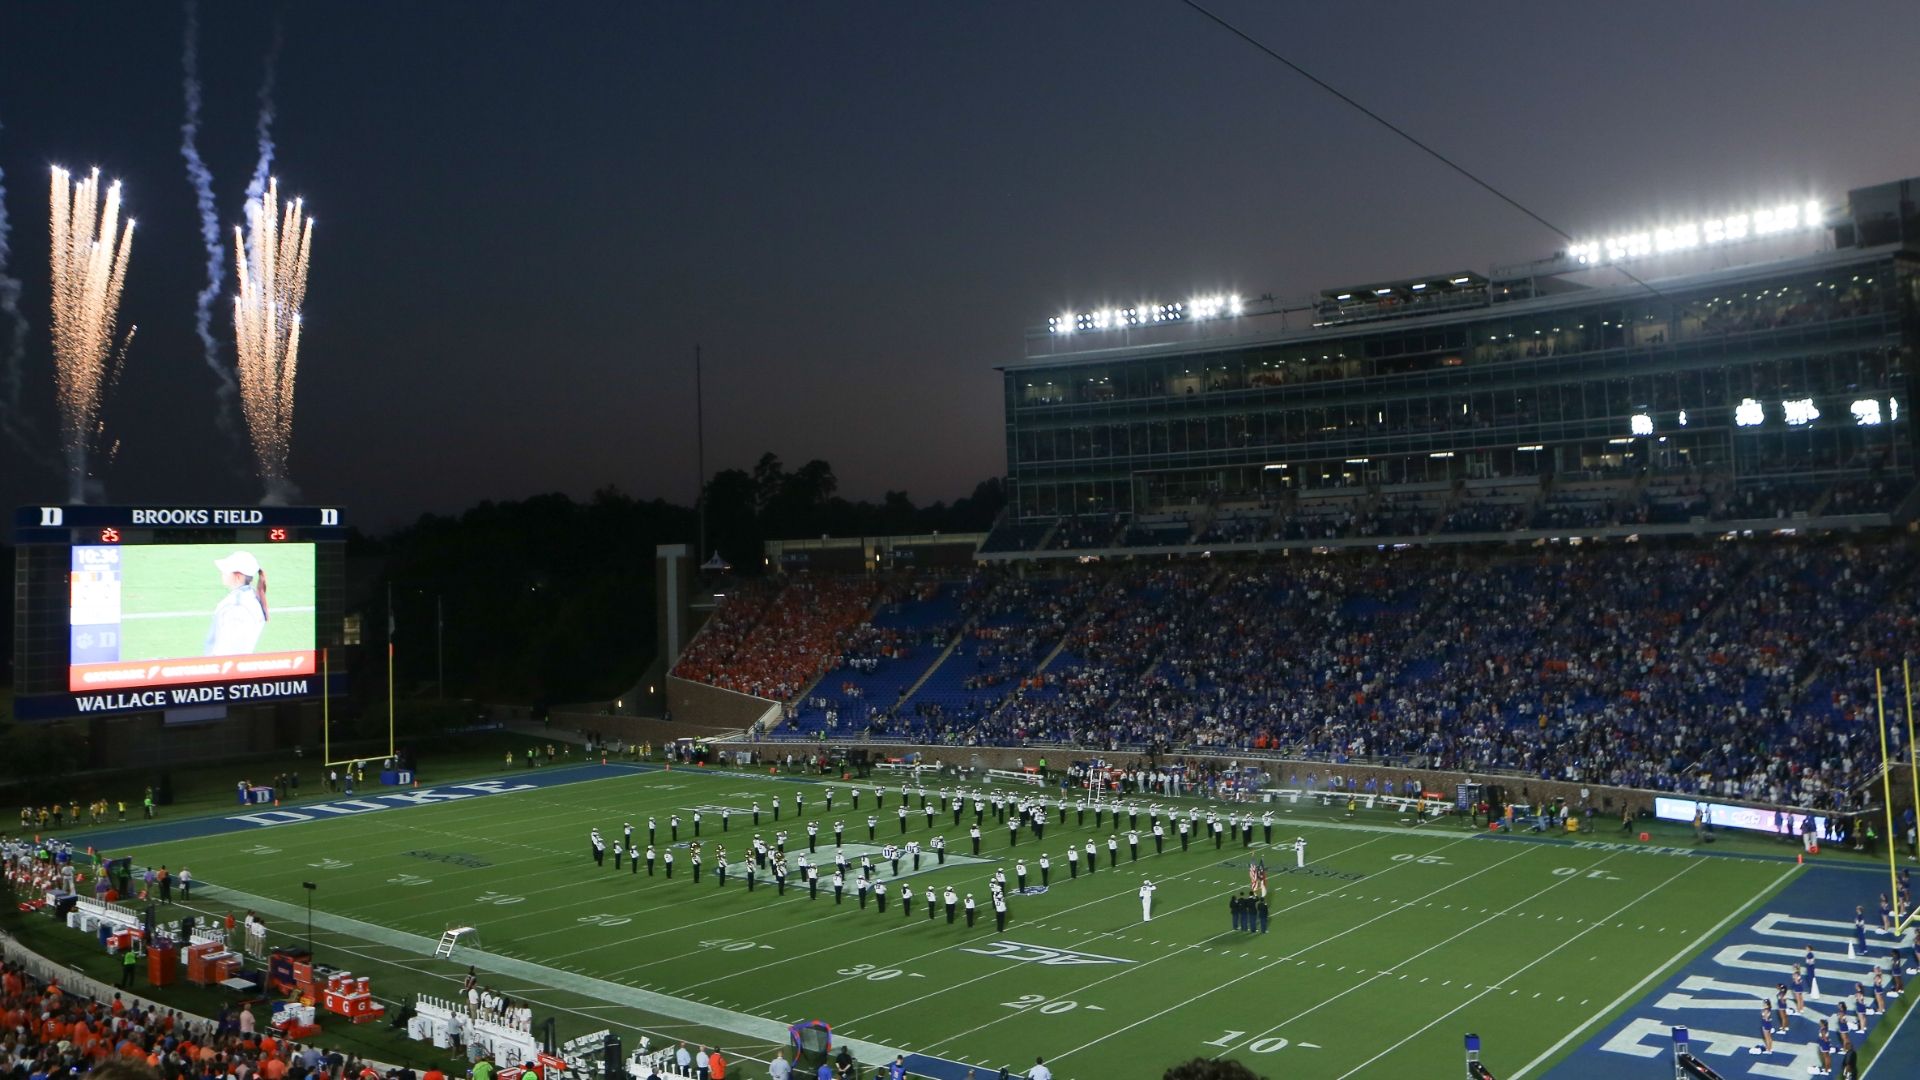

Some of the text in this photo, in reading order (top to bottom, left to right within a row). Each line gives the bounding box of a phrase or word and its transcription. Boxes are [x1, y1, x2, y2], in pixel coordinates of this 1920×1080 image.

[40, 507, 63, 526] D
[132, 509, 263, 525] BROOKS FIELD
[320, 508, 338, 526] D
[102, 530, 120, 543] 25
[270, 529, 285, 540] 25
[75, 680, 308, 712] WALLACE WADE STADIUM
[225, 780, 538, 827] DUKE
[837, 963, 903, 981] 30
[326, 995, 333, 1007] G
[1000, 994, 1079, 1014] 20
[1599, 912, 1919, 1080] DUKE
[342, 1001, 349, 1012] G
[358, 1002, 365, 1011] G
[1203, 1029, 1289, 1054] 10
